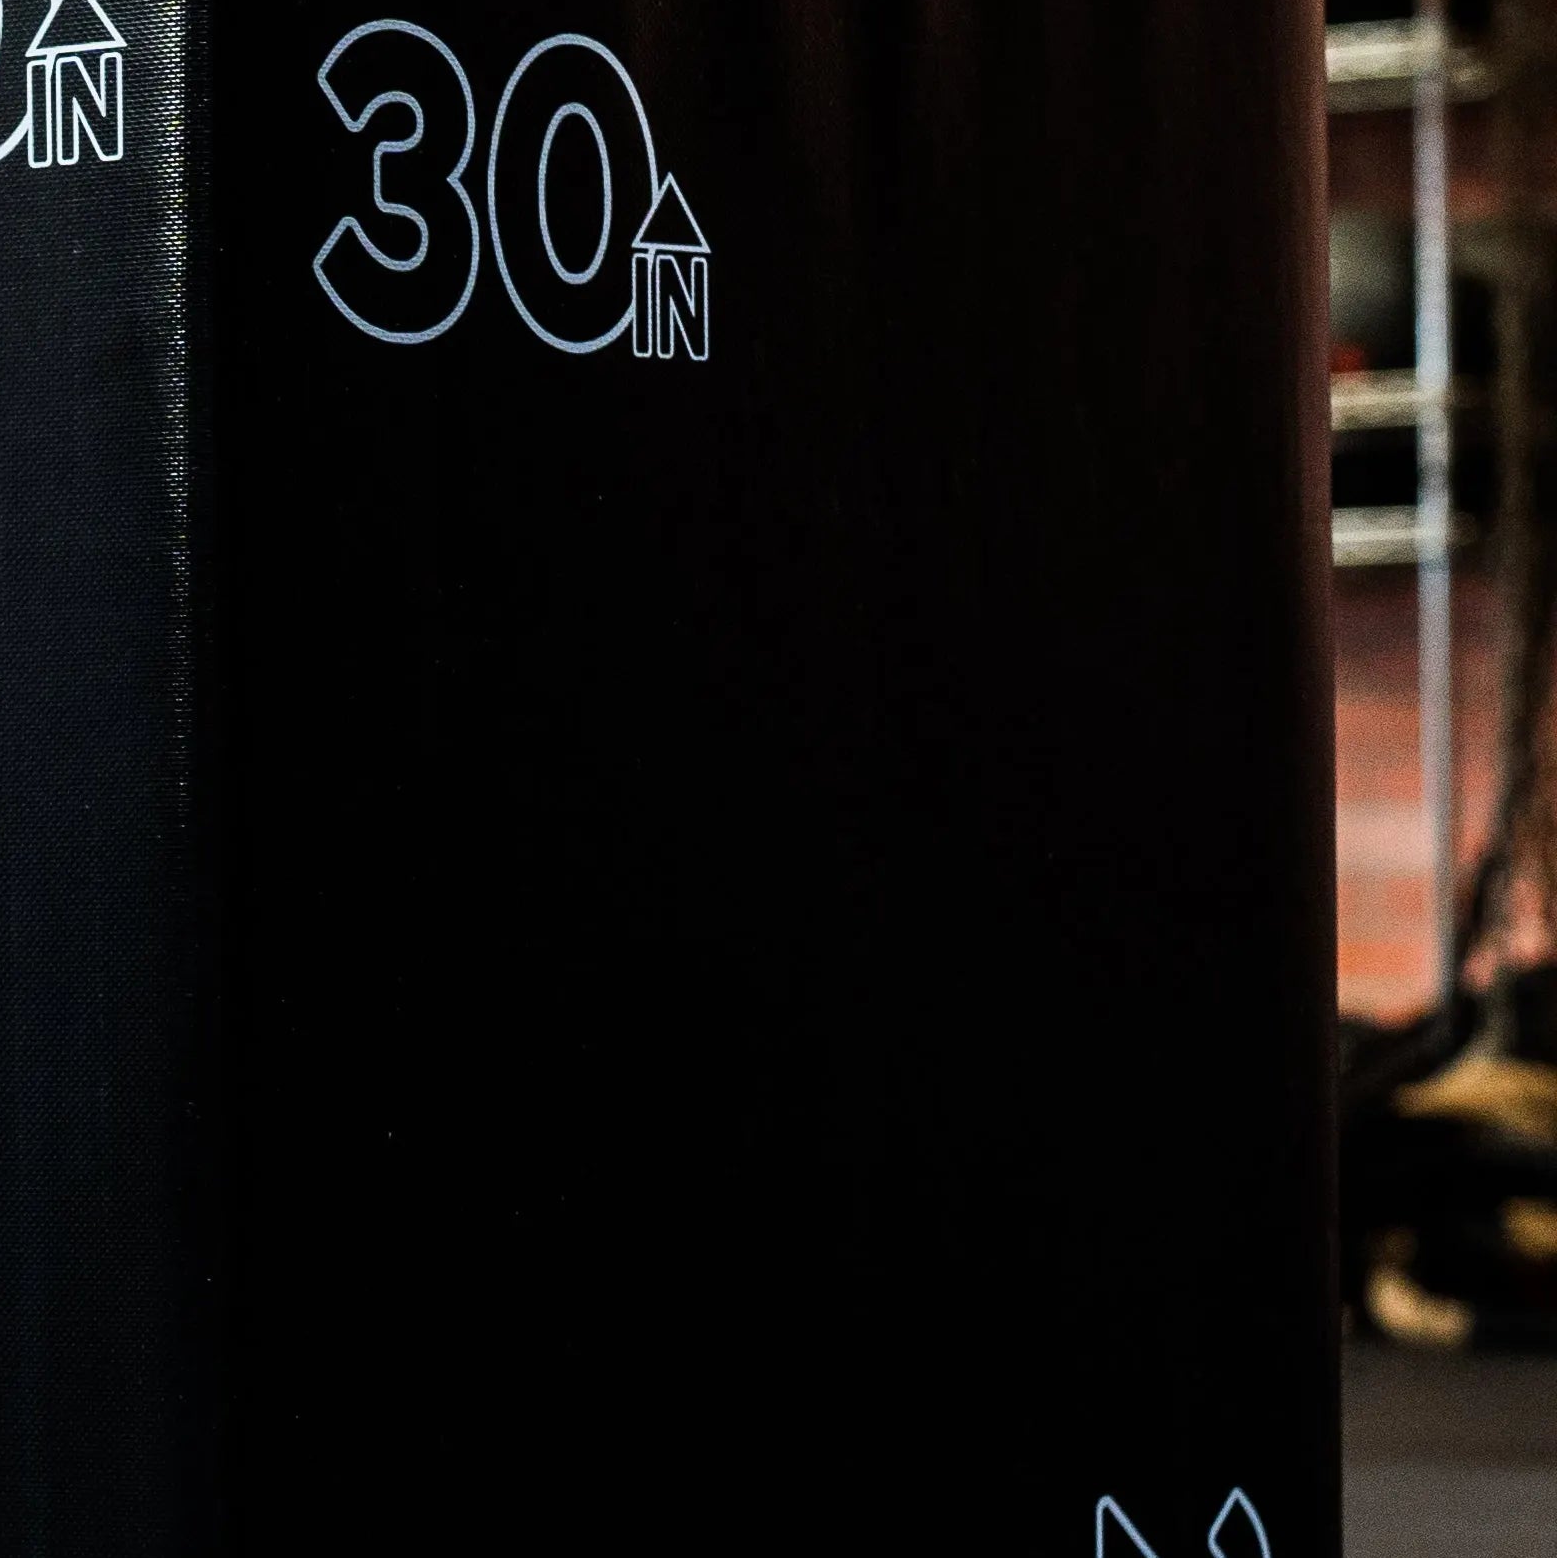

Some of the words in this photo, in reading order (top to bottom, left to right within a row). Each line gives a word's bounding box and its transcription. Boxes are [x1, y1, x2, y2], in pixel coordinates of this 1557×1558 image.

[26, 51, 124, 169] IN
[312, 17, 658, 354] 30
[631, 251, 710, 362] IN
